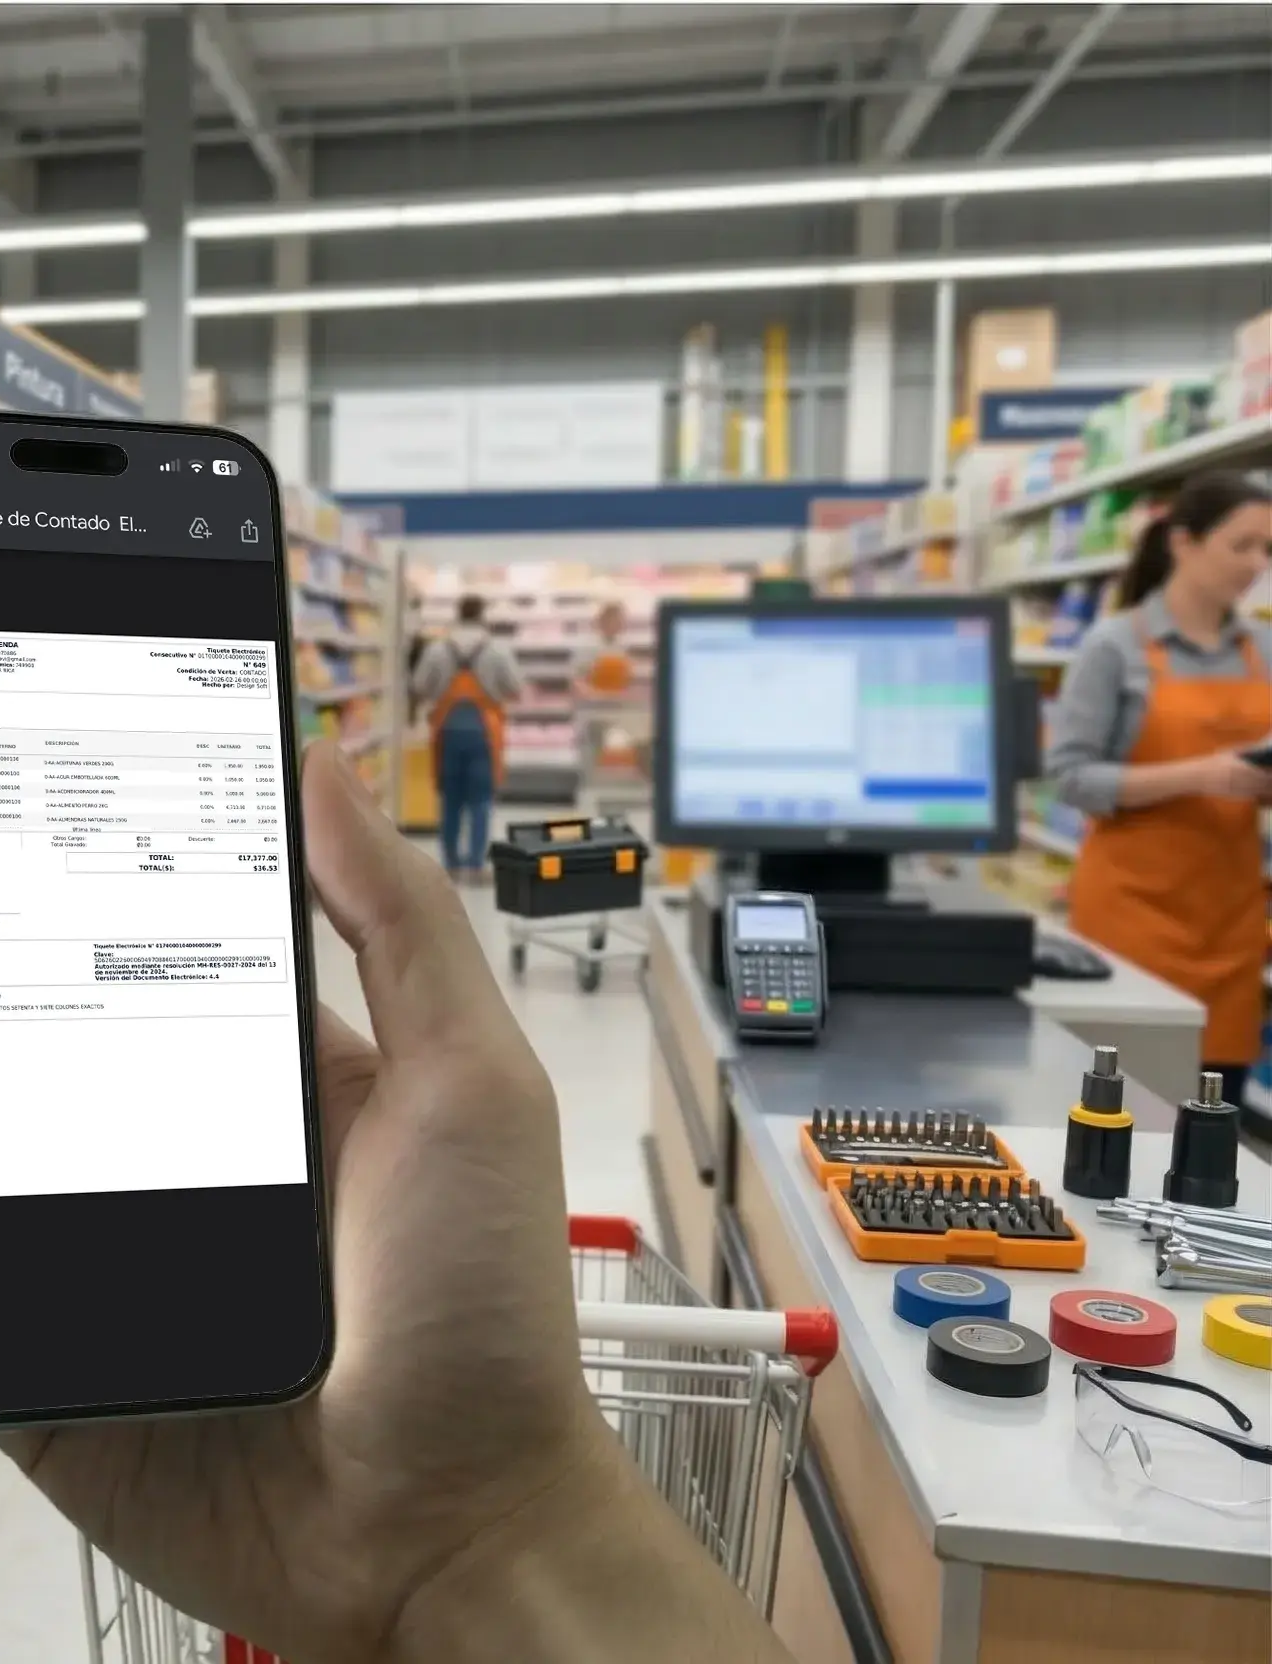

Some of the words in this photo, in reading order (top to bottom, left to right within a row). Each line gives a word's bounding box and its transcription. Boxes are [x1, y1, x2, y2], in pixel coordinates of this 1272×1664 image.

[218, 462, 233, 474] 61
[8, 510, 30, 527] de
[35, 511, 110, 532] Contado
